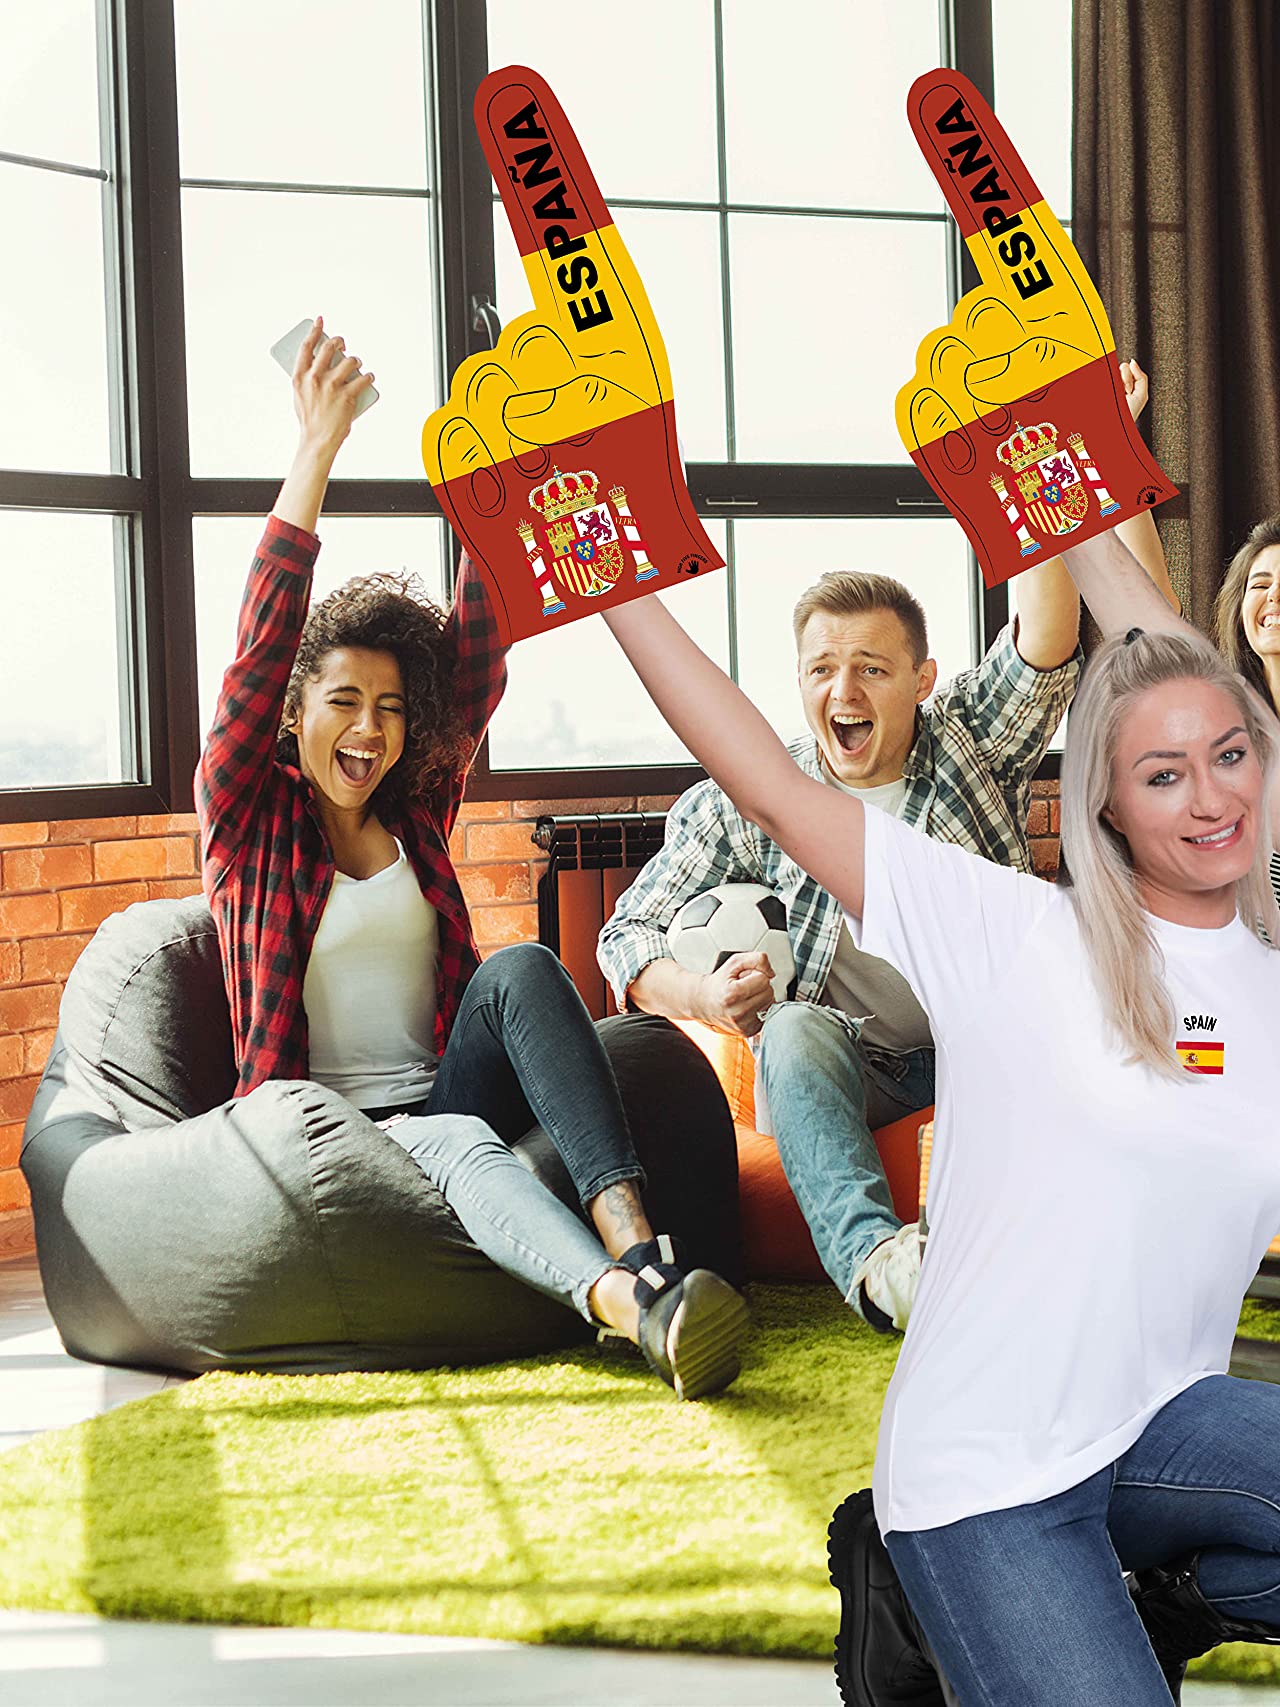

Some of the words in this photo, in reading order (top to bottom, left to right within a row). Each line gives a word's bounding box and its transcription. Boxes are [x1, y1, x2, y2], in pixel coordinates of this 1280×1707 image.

[502, 100, 614, 333] ESPAÑA
[935, 97, 1054, 301] ESPAÑA
[1183, 1015, 1218, 1032] SPAIN
